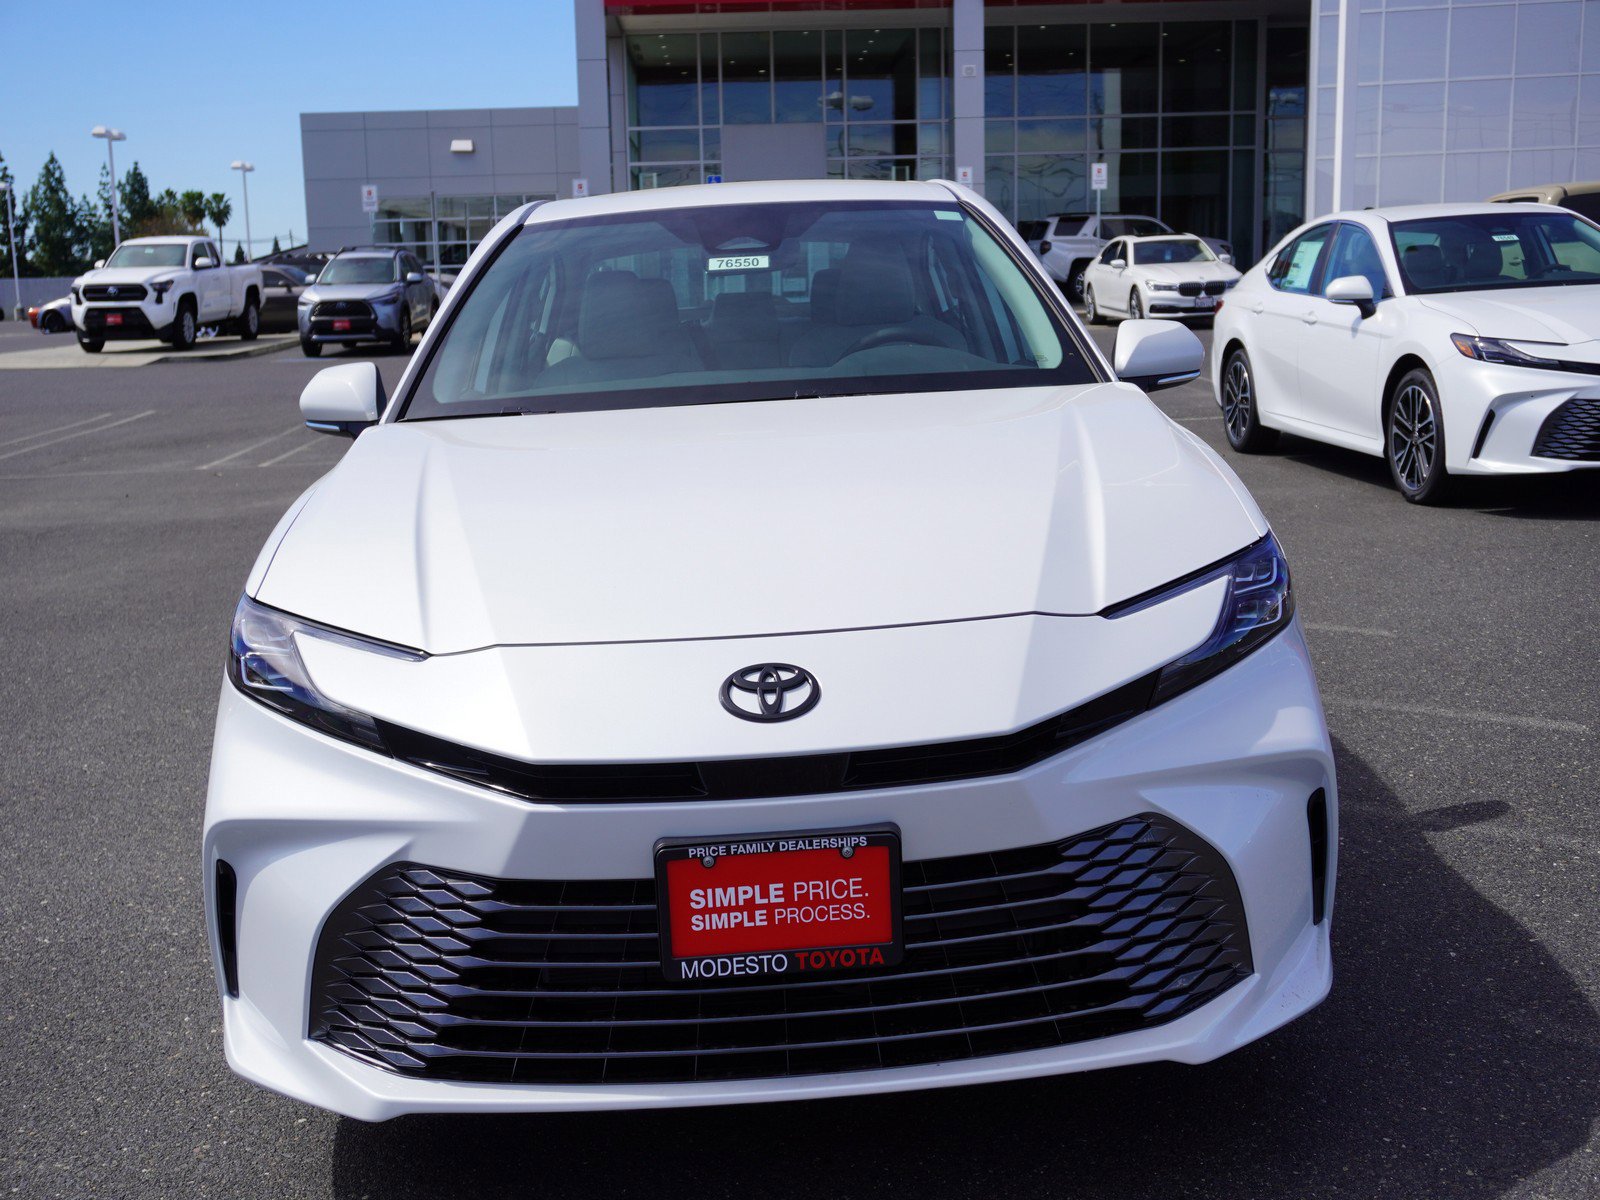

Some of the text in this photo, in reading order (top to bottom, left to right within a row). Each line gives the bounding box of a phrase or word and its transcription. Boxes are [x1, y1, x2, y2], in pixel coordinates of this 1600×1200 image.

[717, 258, 760, 268] 76550
[688, 837, 867, 858] PRICE FAMILY DEALERSHIPS
[690, 878, 869, 909] SIMPLE PRICE.
[691, 903, 870, 931] SIMPLE PROCESS.
[681, 948, 884, 979] MODESTO TOYOTA
